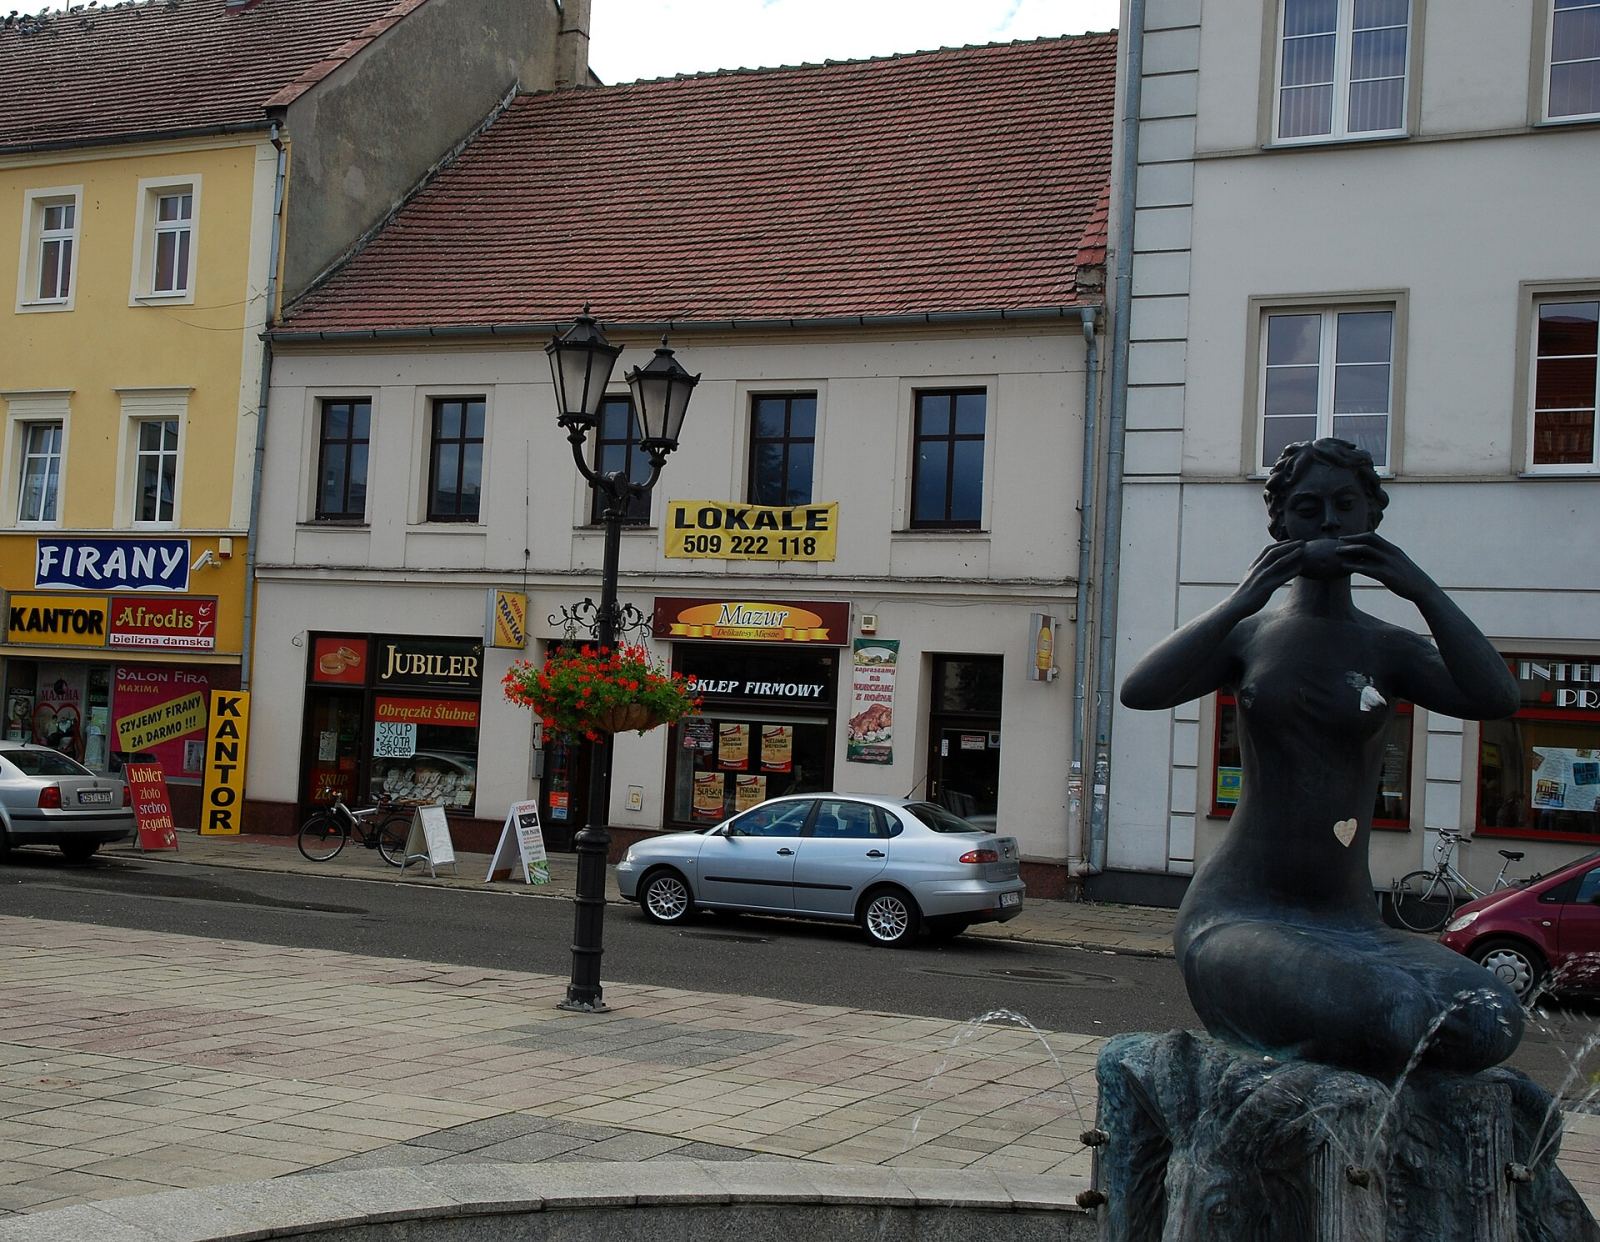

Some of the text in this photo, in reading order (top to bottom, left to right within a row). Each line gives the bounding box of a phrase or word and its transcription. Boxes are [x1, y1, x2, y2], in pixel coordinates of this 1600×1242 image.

[674, 507, 829, 531] LOKALE
[683, 534, 816, 556] 509 222 118
[39, 546, 184, 580] FIRANY
[9, 606, 104, 635] KANTOR
[115, 606, 194, 629] Afrodis
[498, 594, 524, 646] TRAFIKA
[717, 603, 789, 628] Mazur
[112, 635, 211, 647] bielizna damska
[381, 644, 478, 680] JUBILER
[855, 667, 896, 676] zapraszamy
[116, 667, 208, 685] SALON FIRA
[118, 683, 159, 694] MAXIMA
[686, 679, 824, 697] SKLEP FIRMOWY
[1556, 688, 1600, 708] PR
[120, 696, 201, 734] SZYJEMY FIRANY
[378, 703, 476, 721] Obrączki Ślubne
[131, 735, 144, 748] ZA
[146, 720, 182, 743] DARMO
[379, 722, 412, 737] SKUP
[208, 697, 242, 830] KANTOR
[131, 767, 162, 783] Jubiler
[139, 801, 167, 815] srebro
[140, 815, 172, 832] zegarki
